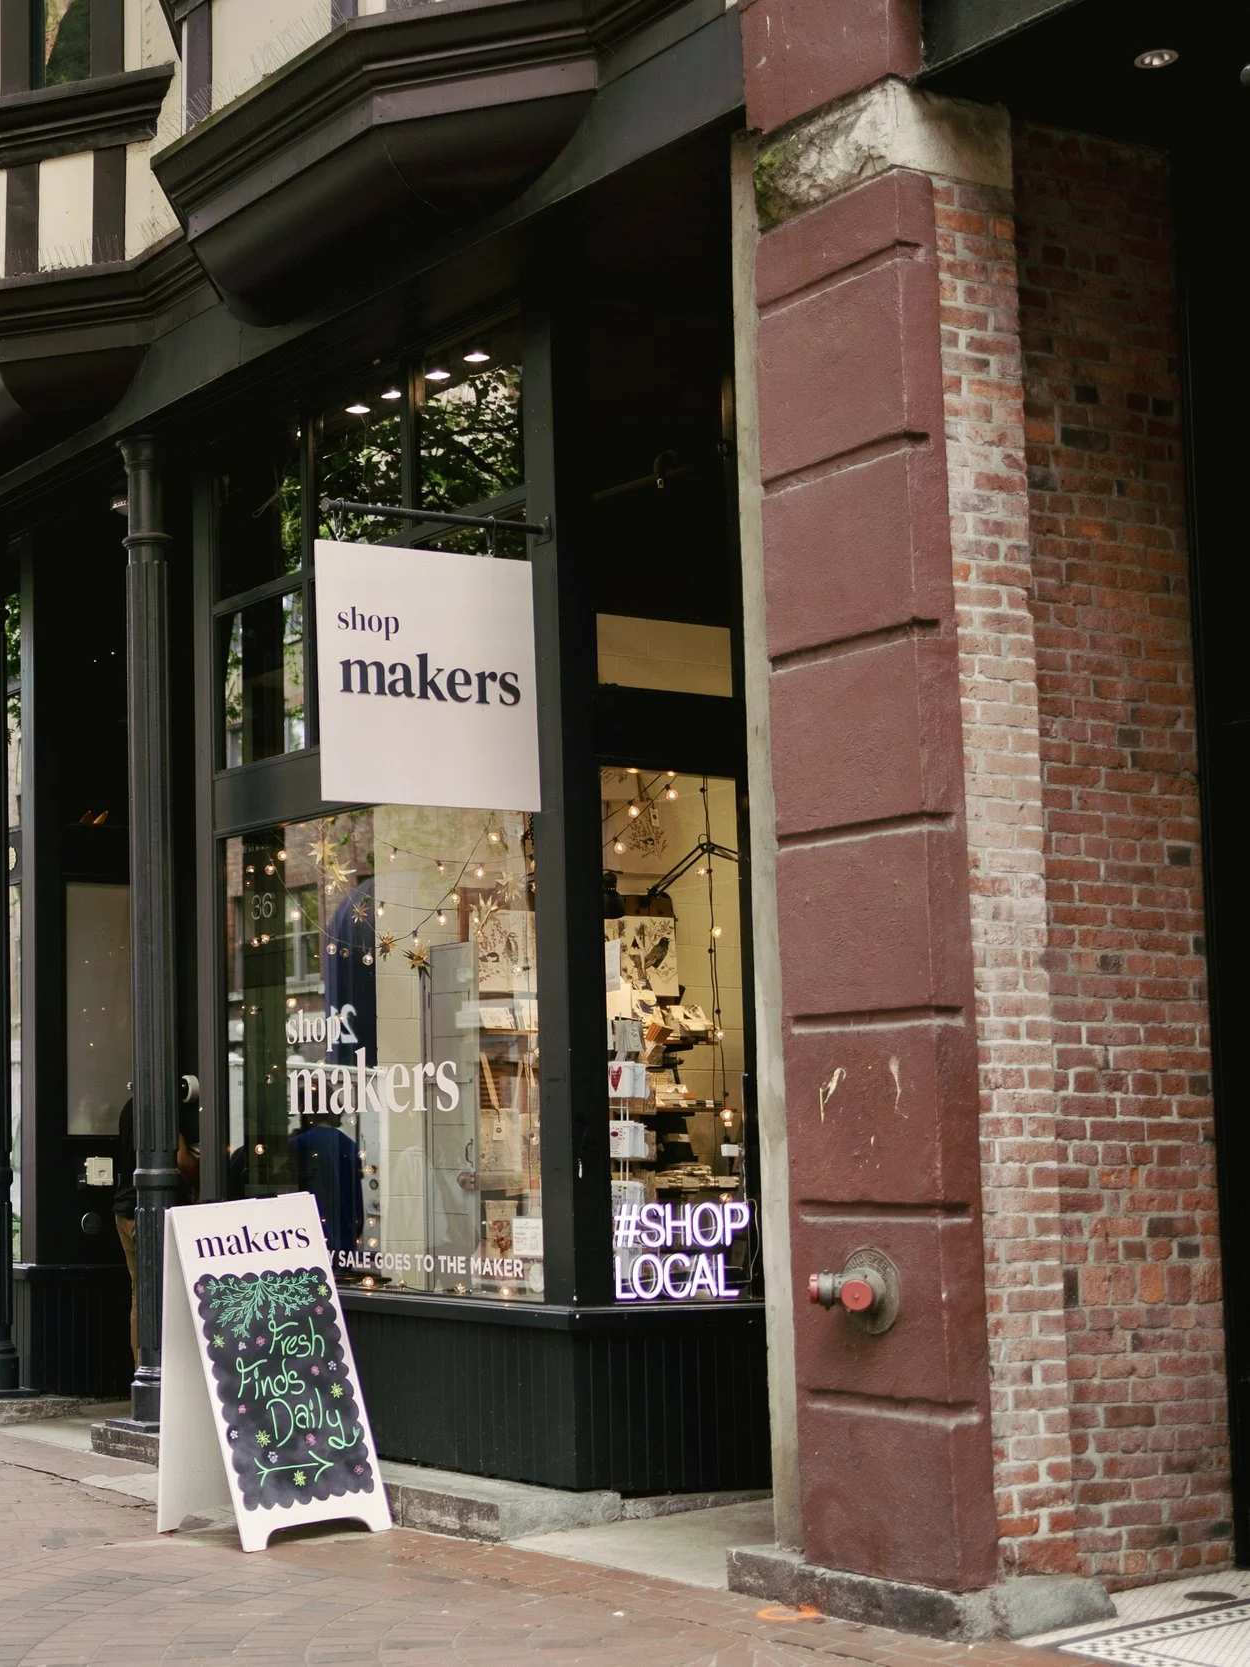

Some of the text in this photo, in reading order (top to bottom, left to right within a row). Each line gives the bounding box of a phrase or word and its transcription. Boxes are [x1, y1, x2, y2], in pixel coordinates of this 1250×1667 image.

[337, 606, 400, 641] shop
[339, 652, 521, 707] makers
[251, 892, 273, 920] 36
[286, 1009, 341, 1052] shop
[287, 1047, 460, 1115] makers
[195, 1225, 310, 1259] makers
[614, 1202, 750, 1248] #SHOP
[338, 1250, 371, 1269] SALE
[374, 1252, 411, 1271] GOES
[414, 1254, 434, 1273] TO
[438, 1255, 466, 1274] THE
[470, 1256, 524, 1278] MAKER
[615, 1253, 740, 1299] LOCAL
[268, 1316, 325, 1358] Fresh
[235, 1357, 305, 1400] Finds
[266, 1387, 361, 1450] Daily
